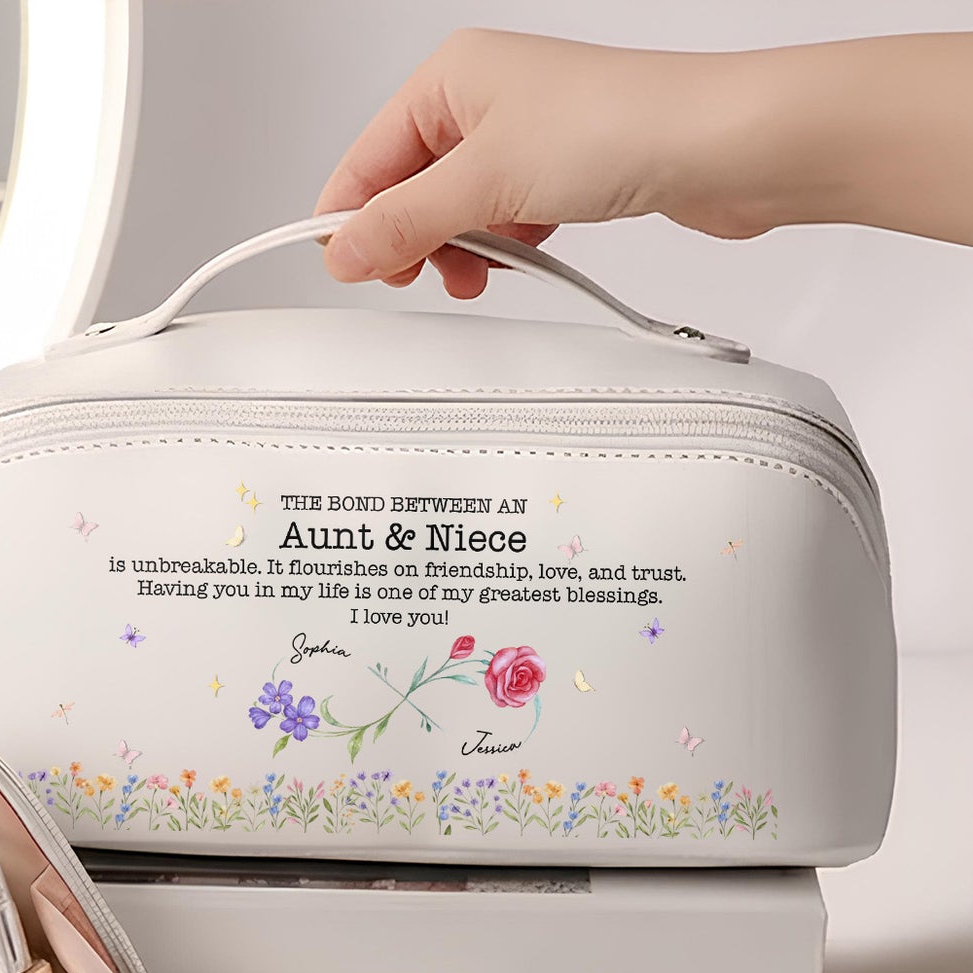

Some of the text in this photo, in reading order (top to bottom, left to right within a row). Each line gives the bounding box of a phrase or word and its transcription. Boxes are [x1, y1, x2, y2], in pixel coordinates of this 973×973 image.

[280, 494, 528, 515] THE BOND BETWEEN AN
[278, 521, 527, 554] Aunt & Niece
[108, 556, 687, 583] is unbreakable. It flourishes on friendship, love, and trust.
[137, 579, 663, 607] Having you in my life is one of my greatest blessings.
[350, 608, 449, 628] I love you!
[289, 632, 352, 665] Sophia
[461, 730, 522, 756] Jessica
